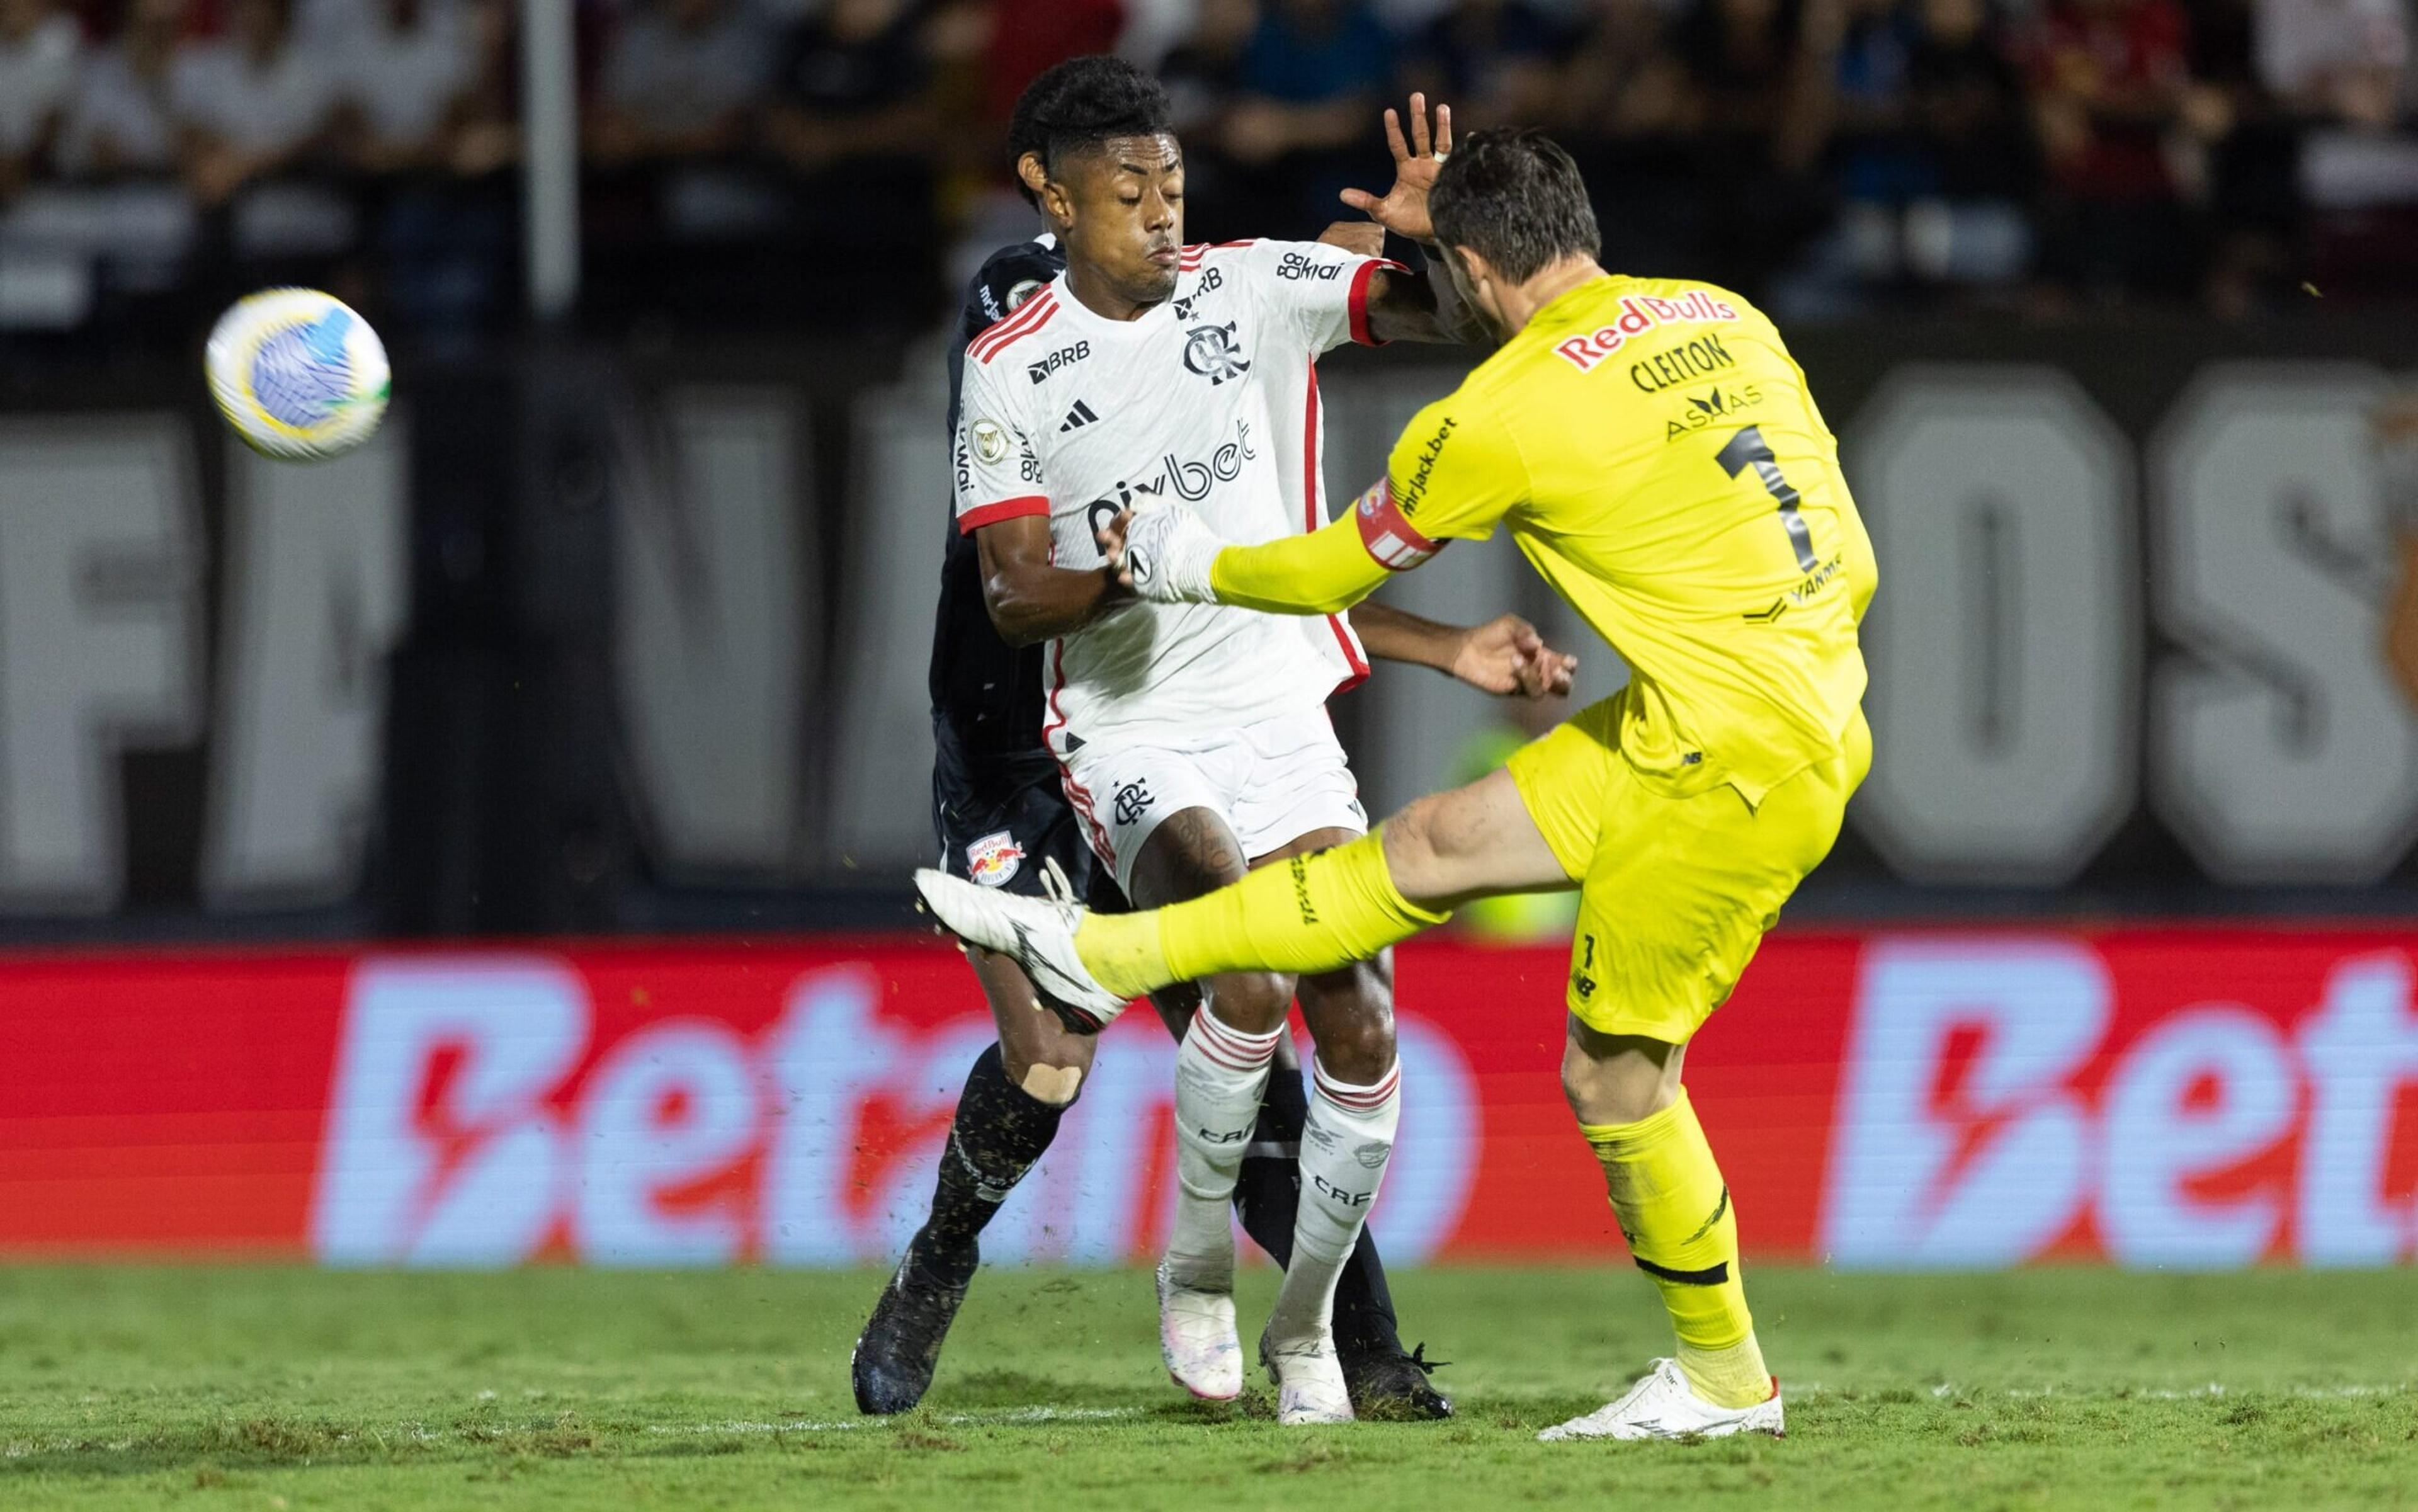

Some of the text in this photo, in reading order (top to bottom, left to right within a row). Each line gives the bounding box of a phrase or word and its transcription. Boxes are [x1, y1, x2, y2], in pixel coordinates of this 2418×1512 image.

[1558, 292, 1737, 369] Red Bulls
[1050, 340, 1091, 374] BRB
[1630, 333, 1734, 393] CLEITON
[1714, 424, 1819, 574] 1
[1584, 933, 1595, 970] 1
[1314, 1174, 1372, 1207] CRF
